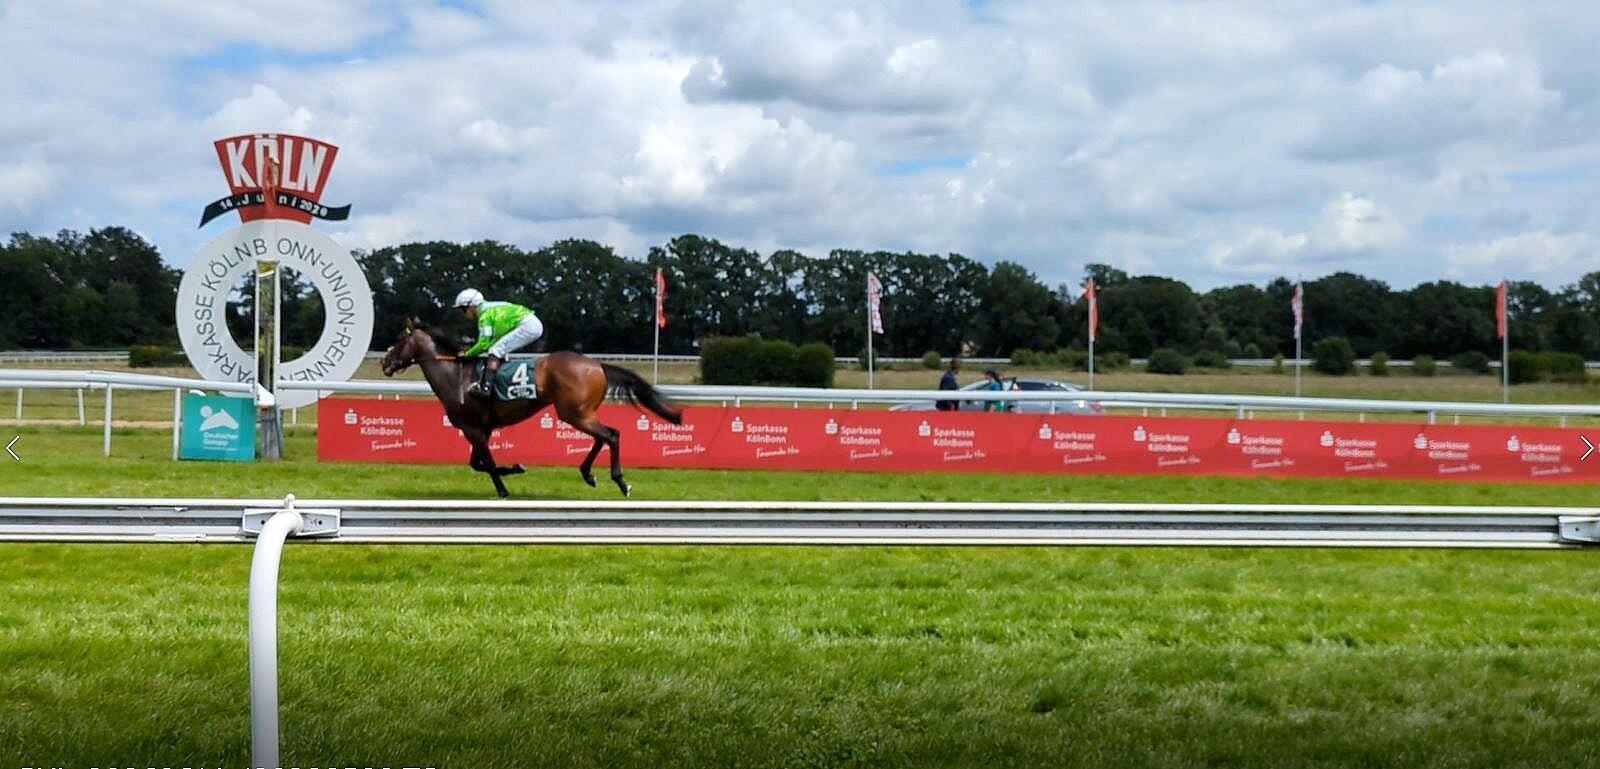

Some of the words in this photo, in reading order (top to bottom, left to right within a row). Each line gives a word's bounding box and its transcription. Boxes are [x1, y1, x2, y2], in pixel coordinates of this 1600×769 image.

[225, 133, 328, 193] KÖLN
[512, 363, 529, 386] 4
[747, 423, 788, 434] Sparkasse
